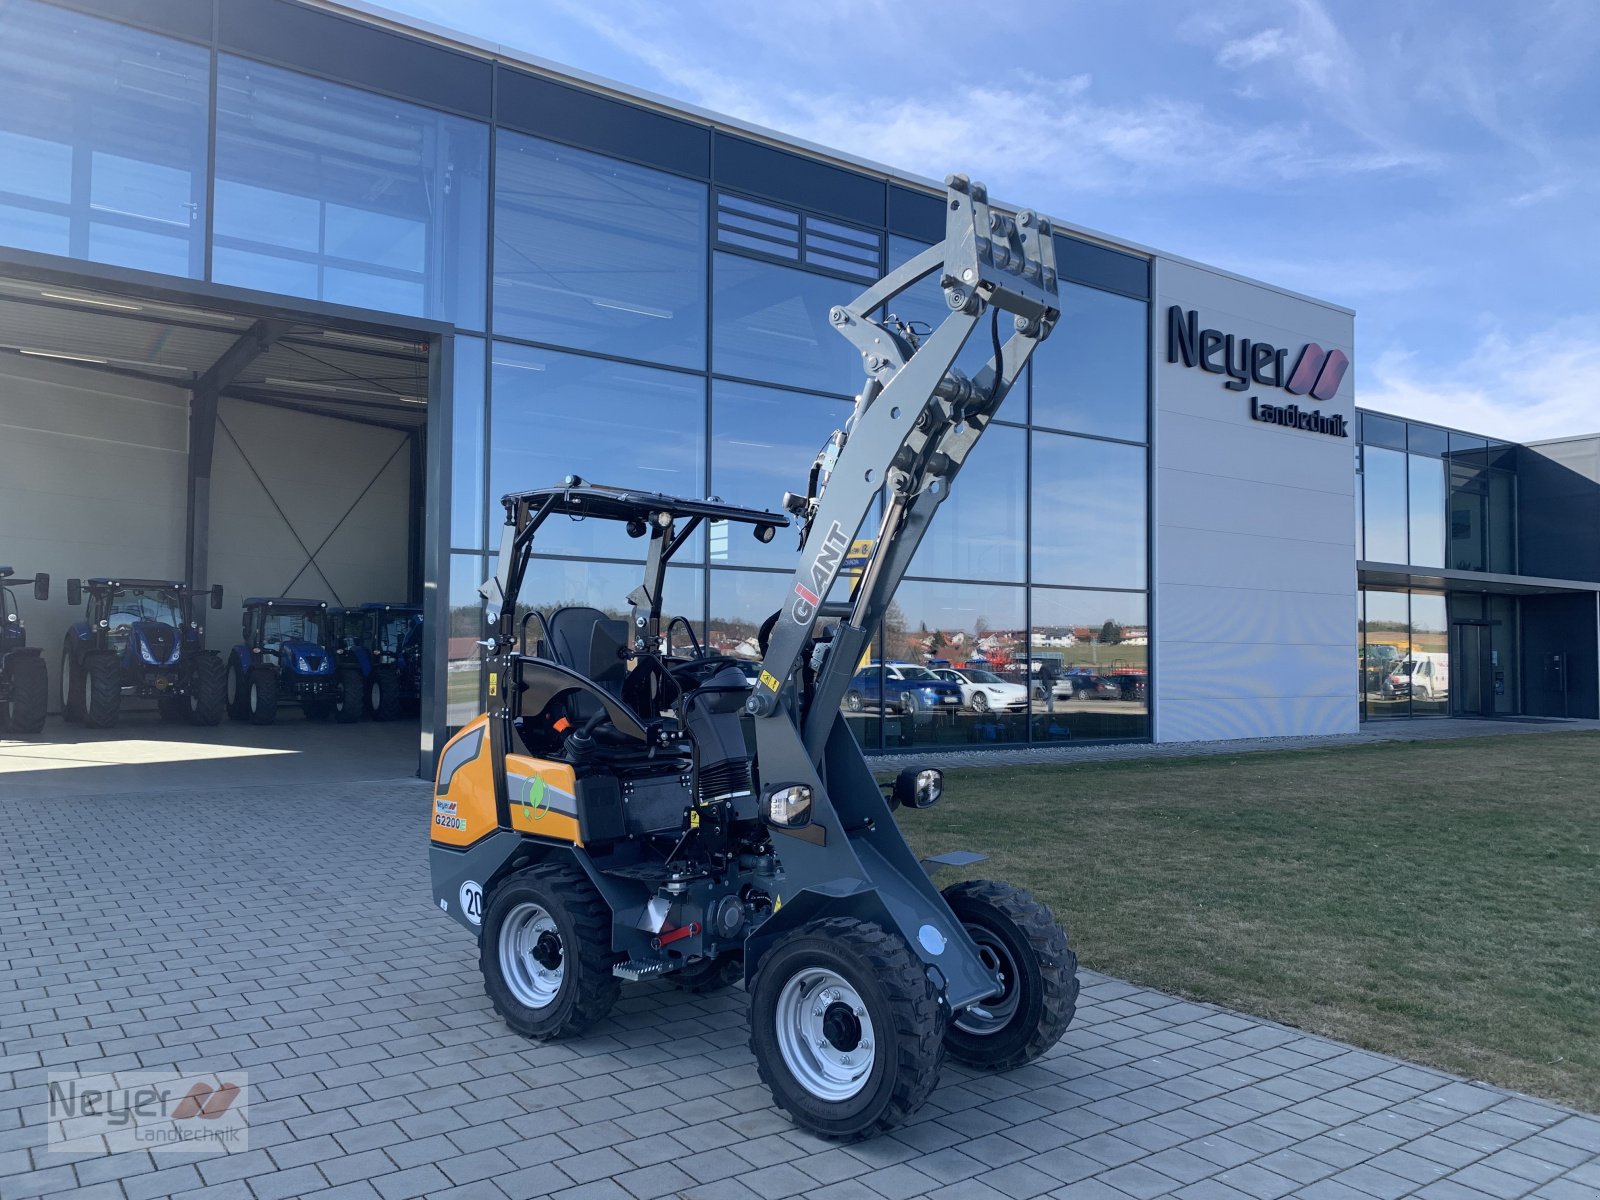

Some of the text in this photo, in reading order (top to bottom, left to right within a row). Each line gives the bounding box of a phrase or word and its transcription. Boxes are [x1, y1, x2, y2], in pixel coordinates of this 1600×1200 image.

[1168, 304, 1288, 392] Neyer
[1250, 396, 1348, 437] Landtechnik
[792, 520, 849, 625] GIANT
[465, 888, 482, 917] 20
